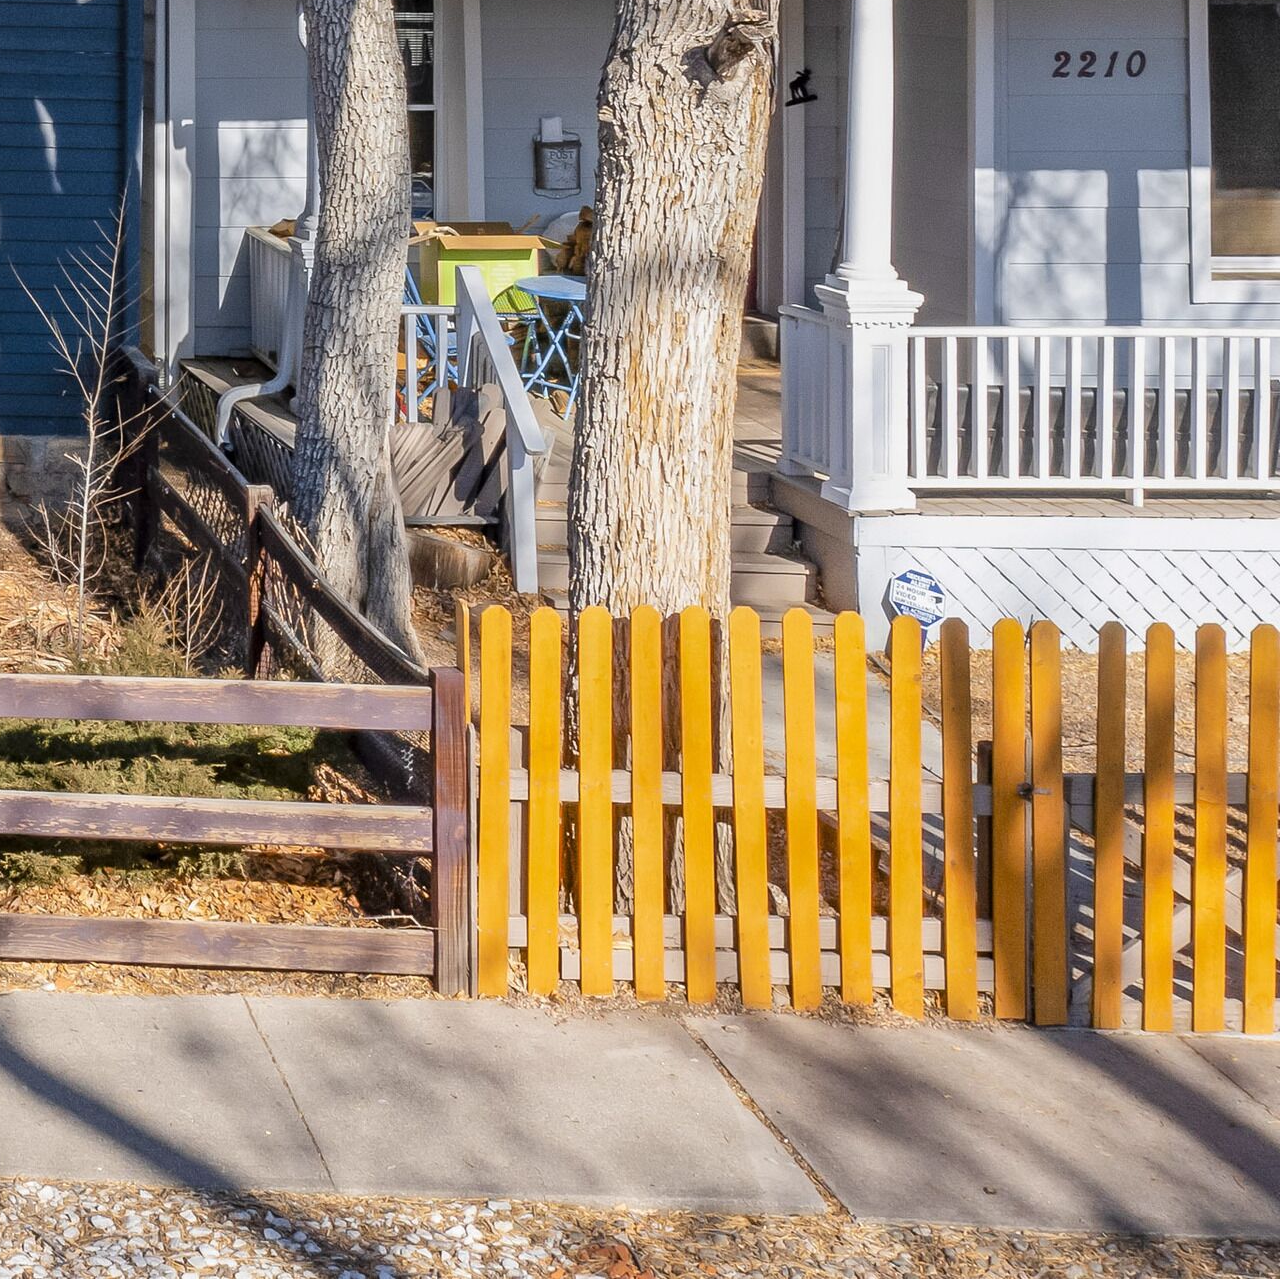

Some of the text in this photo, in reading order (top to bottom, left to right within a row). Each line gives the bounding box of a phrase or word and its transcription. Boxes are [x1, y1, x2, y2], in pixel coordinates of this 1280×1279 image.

[1052, 50, 1146, 78] 2210
[550, 151, 573, 159] POST
[895, 590, 917, 601] VIDEO
[906, 586, 926, 596] HOUR
